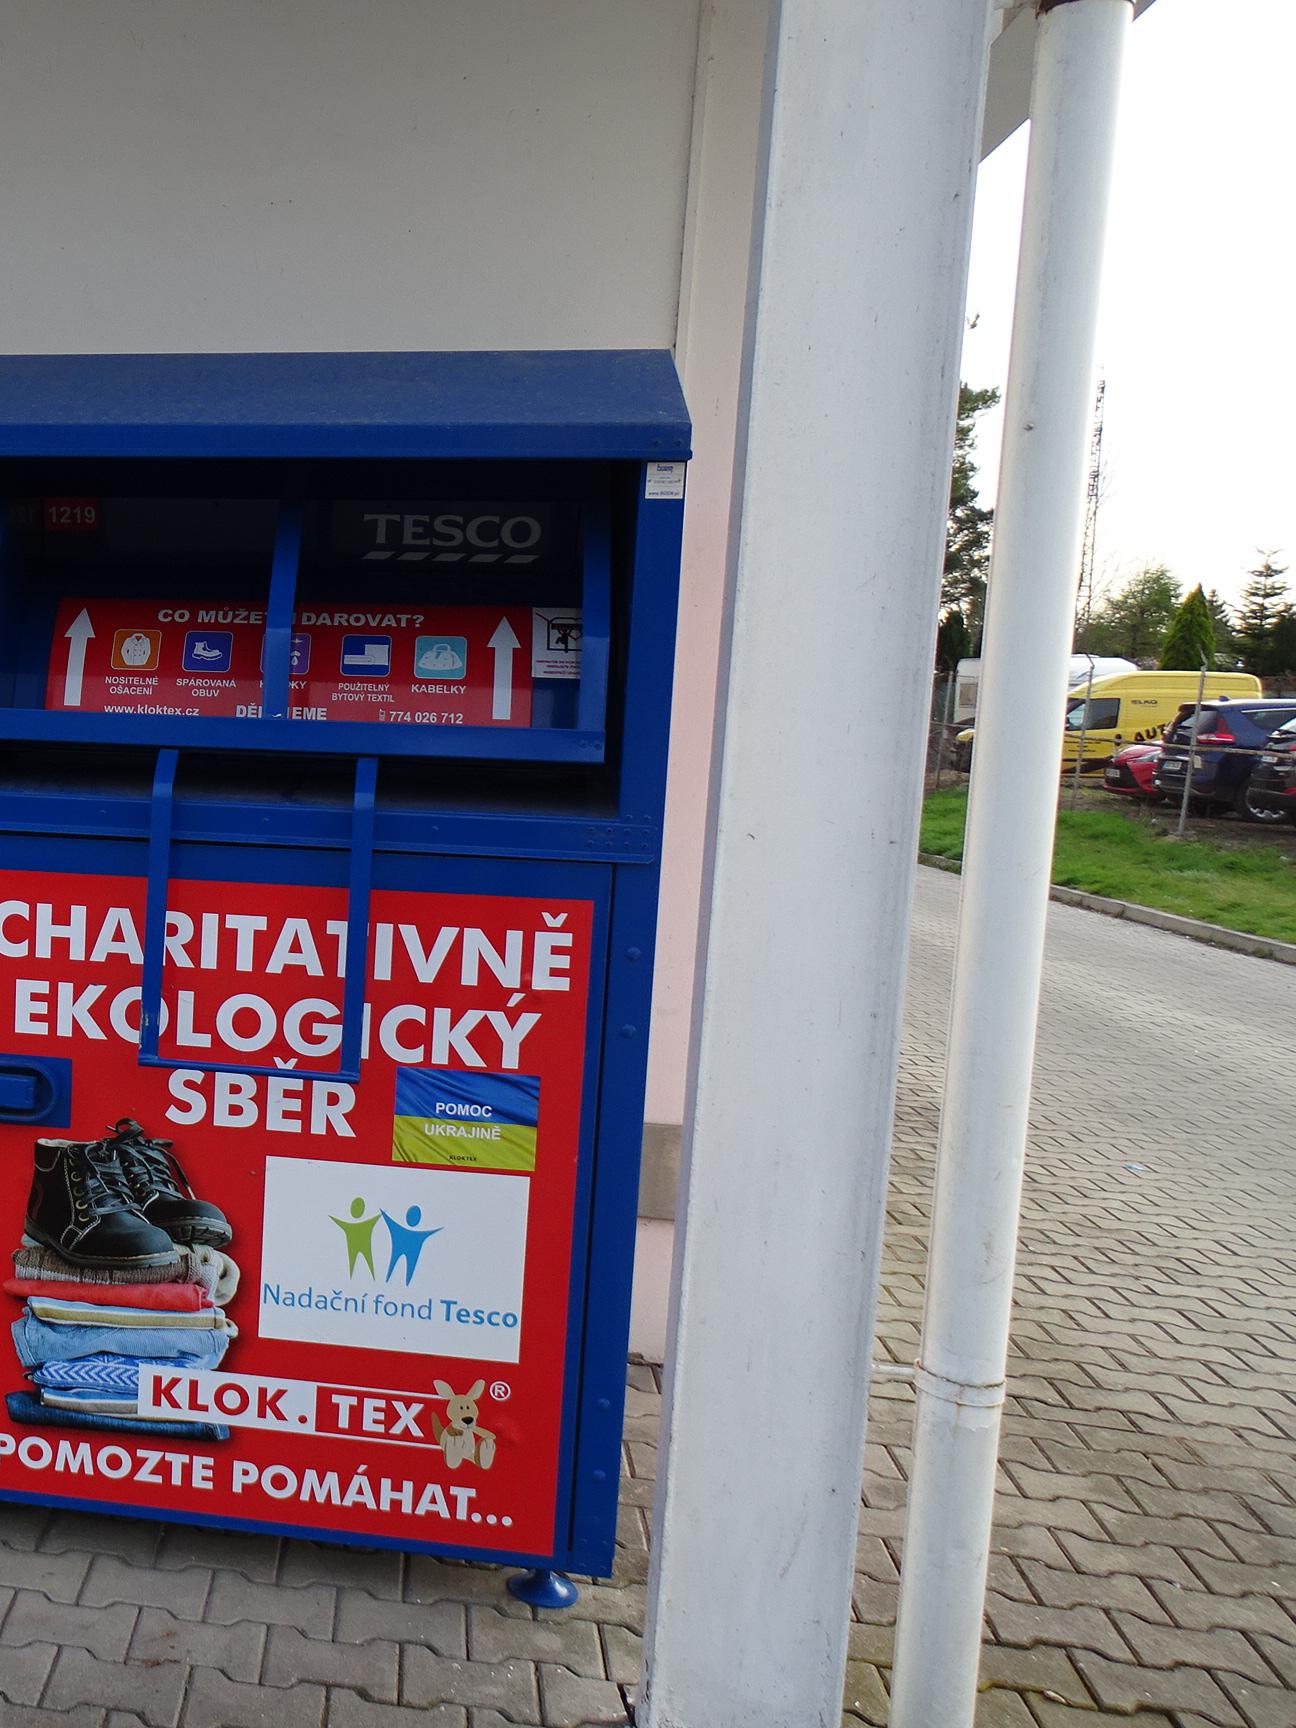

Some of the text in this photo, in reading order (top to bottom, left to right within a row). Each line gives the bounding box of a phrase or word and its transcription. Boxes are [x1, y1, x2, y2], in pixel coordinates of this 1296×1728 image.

[48, 507, 96, 524] 1219
[363, 513, 542, 549] TESCO
[158, 606, 424, 628] CO MŮŽE DAROVAT?
[105, 676, 159, 686] NOSITELNÉ
[176, 678, 237, 688] SPÁROVANÁ
[338, 681, 390, 692] POUŽITELNÝ
[109, 685, 153, 695] OŠACENÍ
[191, 689, 220, 697] OBUV
[411, 684, 467, 694] KABELKY
[331, 692, 395, 703] BYTOVÝ TEXTIL
[104, 704, 200, 716] www.kloktex.cz
[389, 711, 463, 724] 774 026 712
[165, 1056, 357, 1138] SBĚR
[435, 1102, 492, 1117] POMOC
[424, 1124, 502, 1140] UKRAJINĚ
[263, 1284, 518, 1329] Nadační fond Tesco
[332, 1395, 425, 1438] TEX
[233, 1460, 513, 1527] POMÁHAT...
